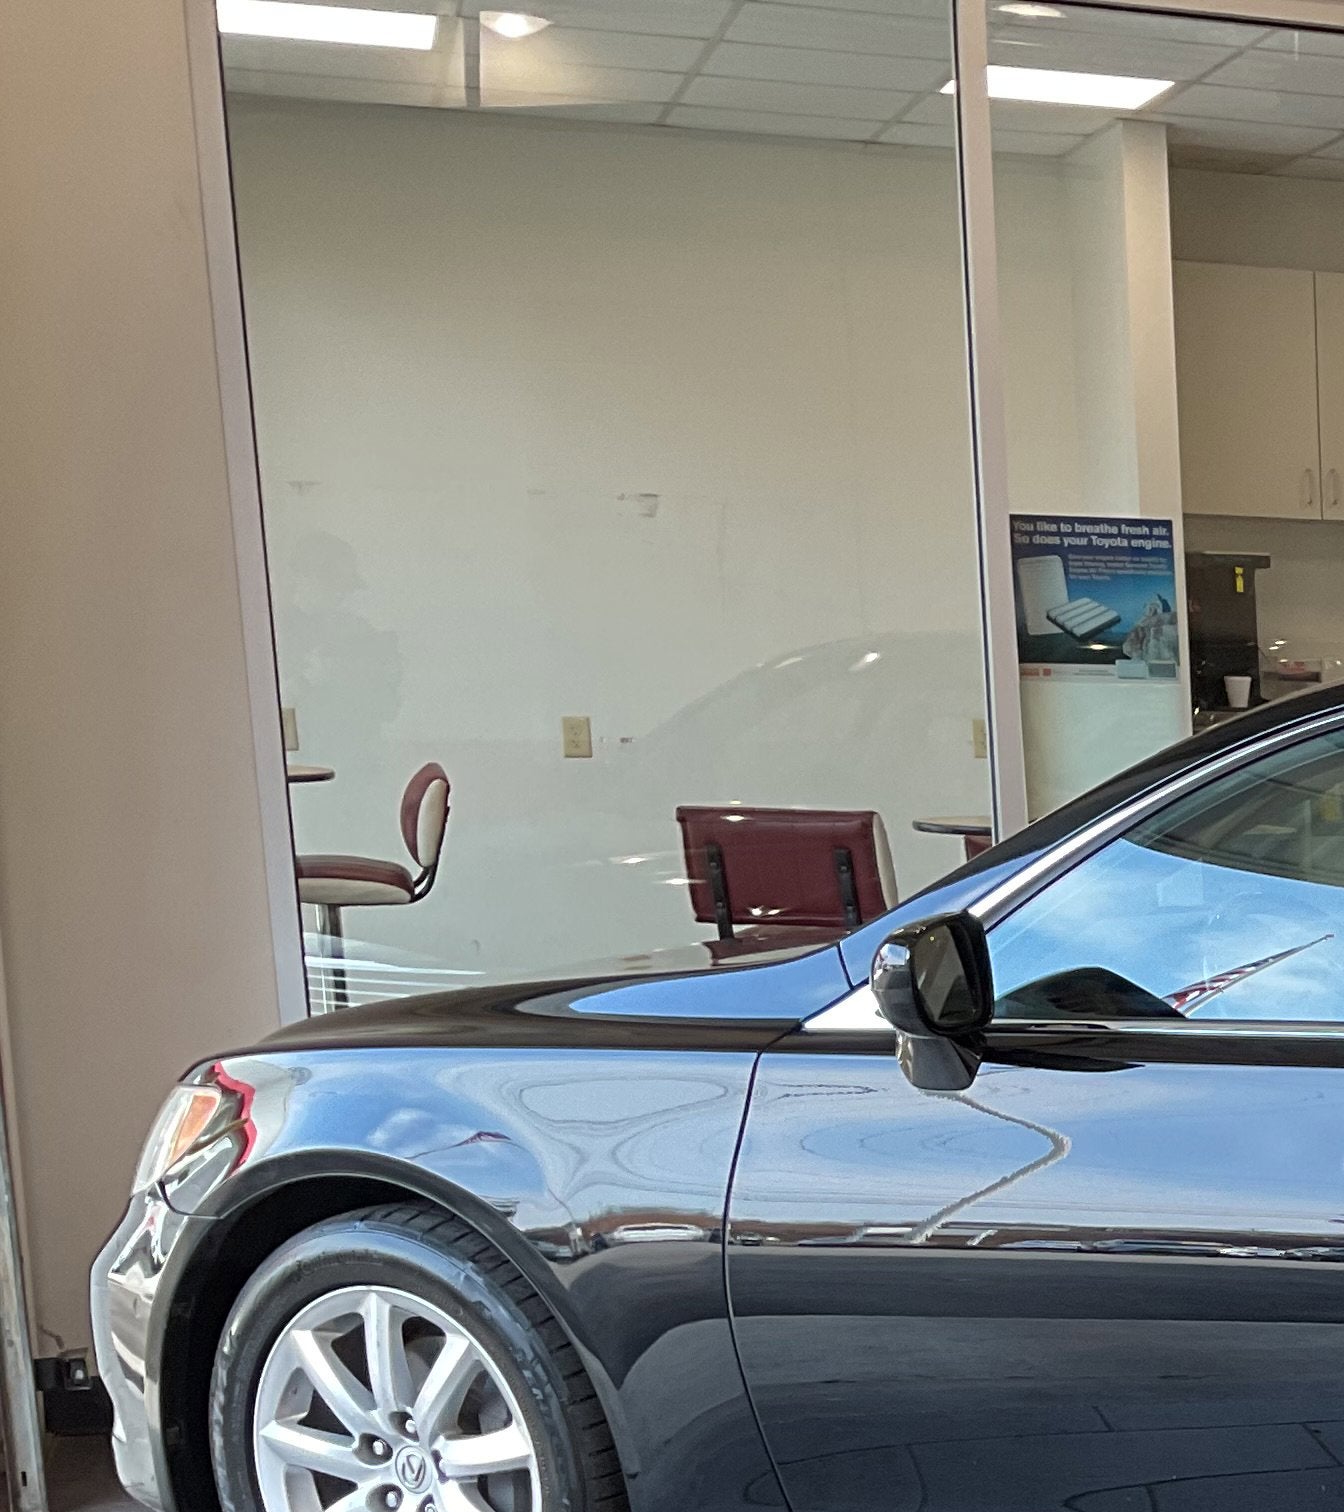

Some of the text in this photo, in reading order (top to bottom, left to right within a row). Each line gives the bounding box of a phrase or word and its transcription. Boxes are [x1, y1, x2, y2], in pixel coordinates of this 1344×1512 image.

[1013, 521, 1169, 536] You like to breathe fresh air.
[1013, 534, 1172, 551] So does your Toyota engine.
